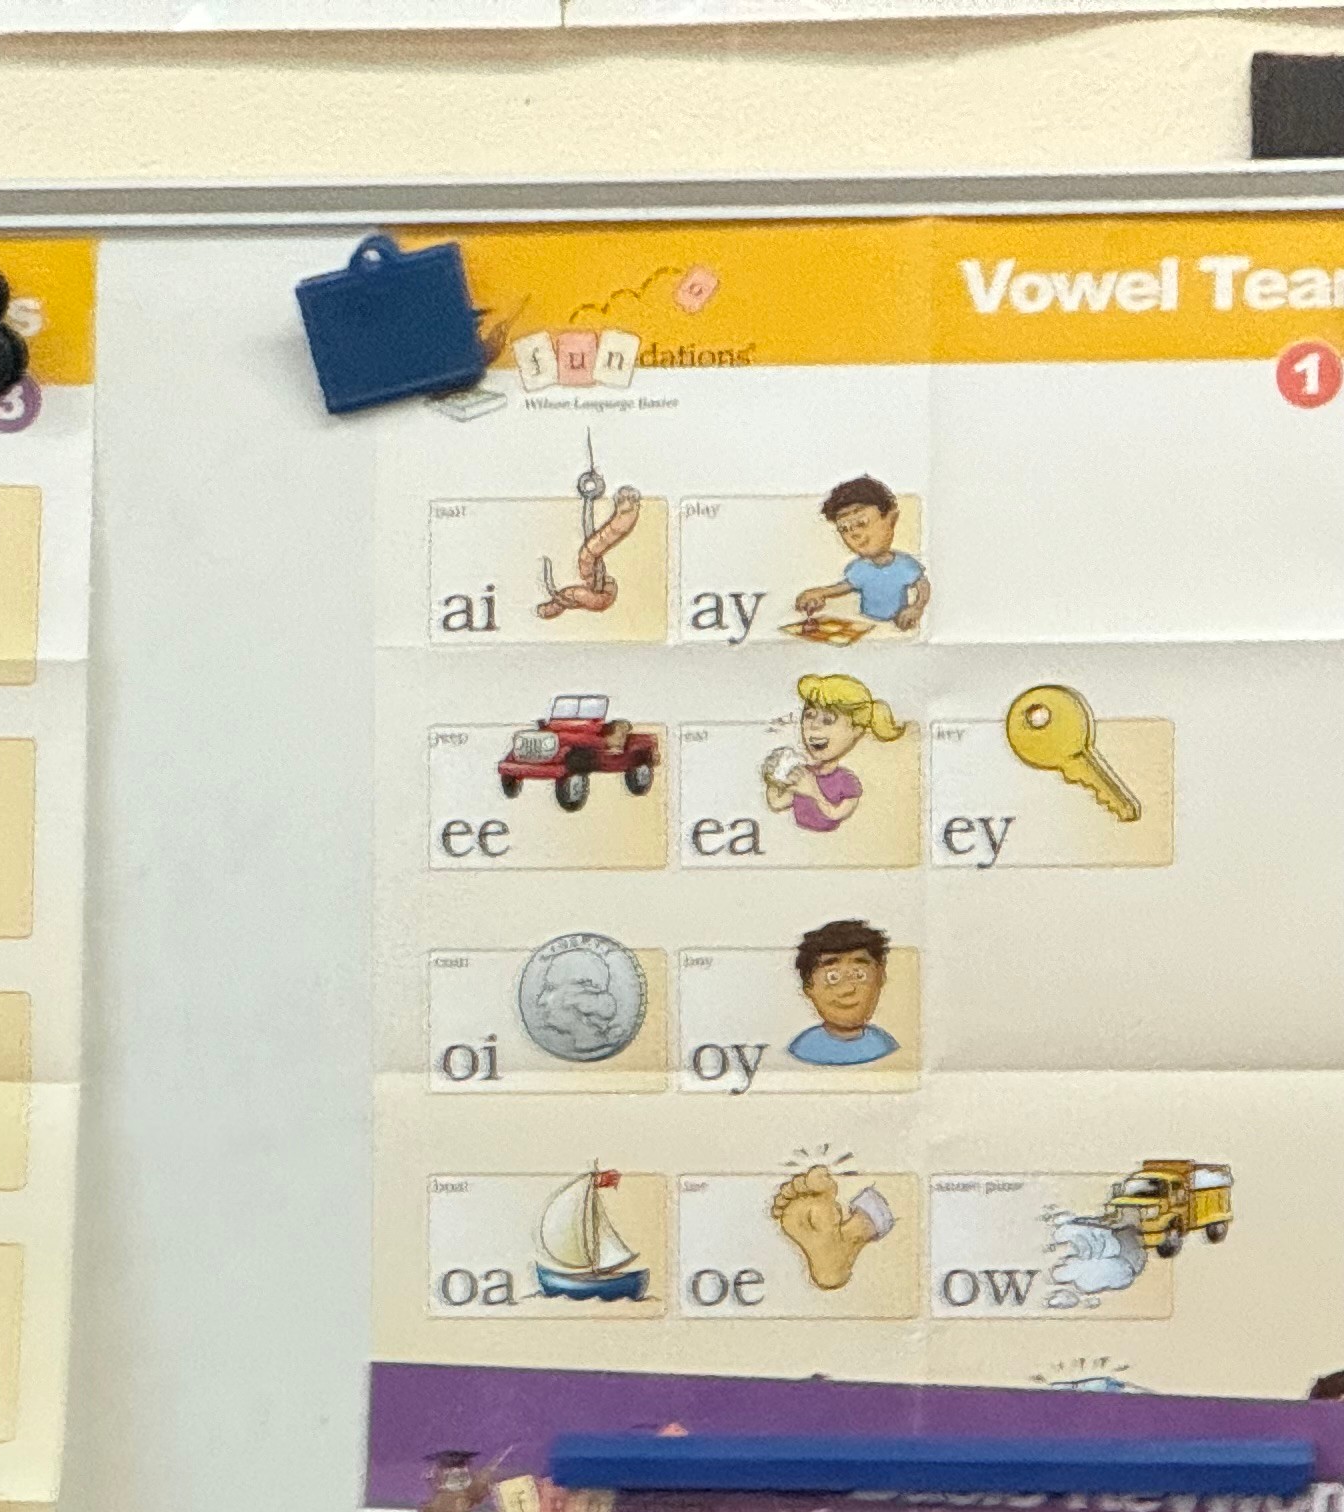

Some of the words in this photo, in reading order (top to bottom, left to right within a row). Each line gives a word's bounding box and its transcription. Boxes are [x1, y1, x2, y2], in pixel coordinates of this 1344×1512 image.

[960, 257, 1179, 313] Vowel
[1198, 255, 1344, 311] Tea
[1293, 353, 1320, 395] 1
[442, 584, 499, 632] ai
[691, 591, 766, 646] ay
[441, 818, 511, 858] ee
[691, 816, 766, 856] ea
[943, 815, 1016, 869] ey
[441, 1033, 502, 1082] oi
[691, 1043, 769, 1095] oy
[441, 1267, 518, 1306] oa
[691, 1267, 767, 1306] oe
[941, 1269, 1042, 1306] ow
